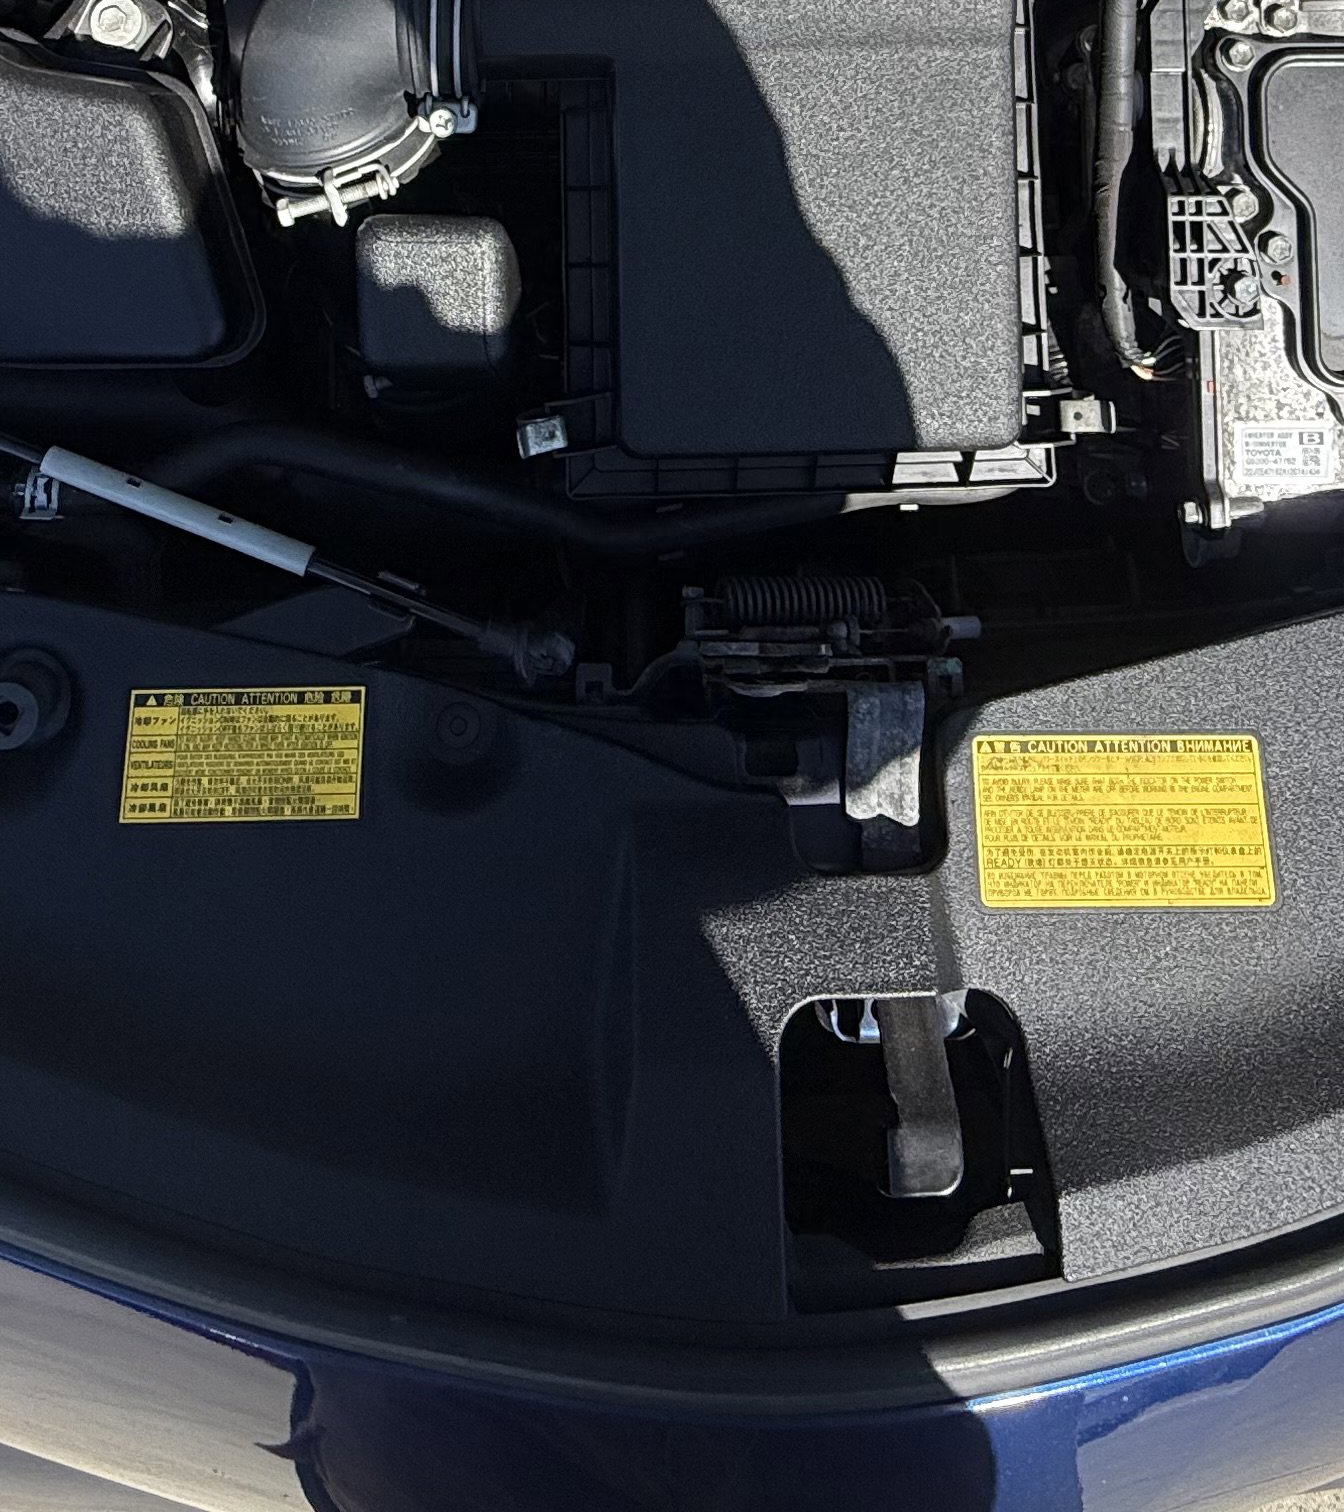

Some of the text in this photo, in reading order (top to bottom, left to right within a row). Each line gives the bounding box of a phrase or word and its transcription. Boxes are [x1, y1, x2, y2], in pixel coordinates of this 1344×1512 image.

[1303, 432, 1321, 445] B
[1244, 449, 1282, 457] TOYOTA
[191, 691, 298, 705] CAUTION ATTENTION
[1027, 740, 1171, 753] CAUTION ATTENTION
[1176, 739, 1251, 753] ВНИМАНИЕ
[986, 857, 1022, 868] READY
